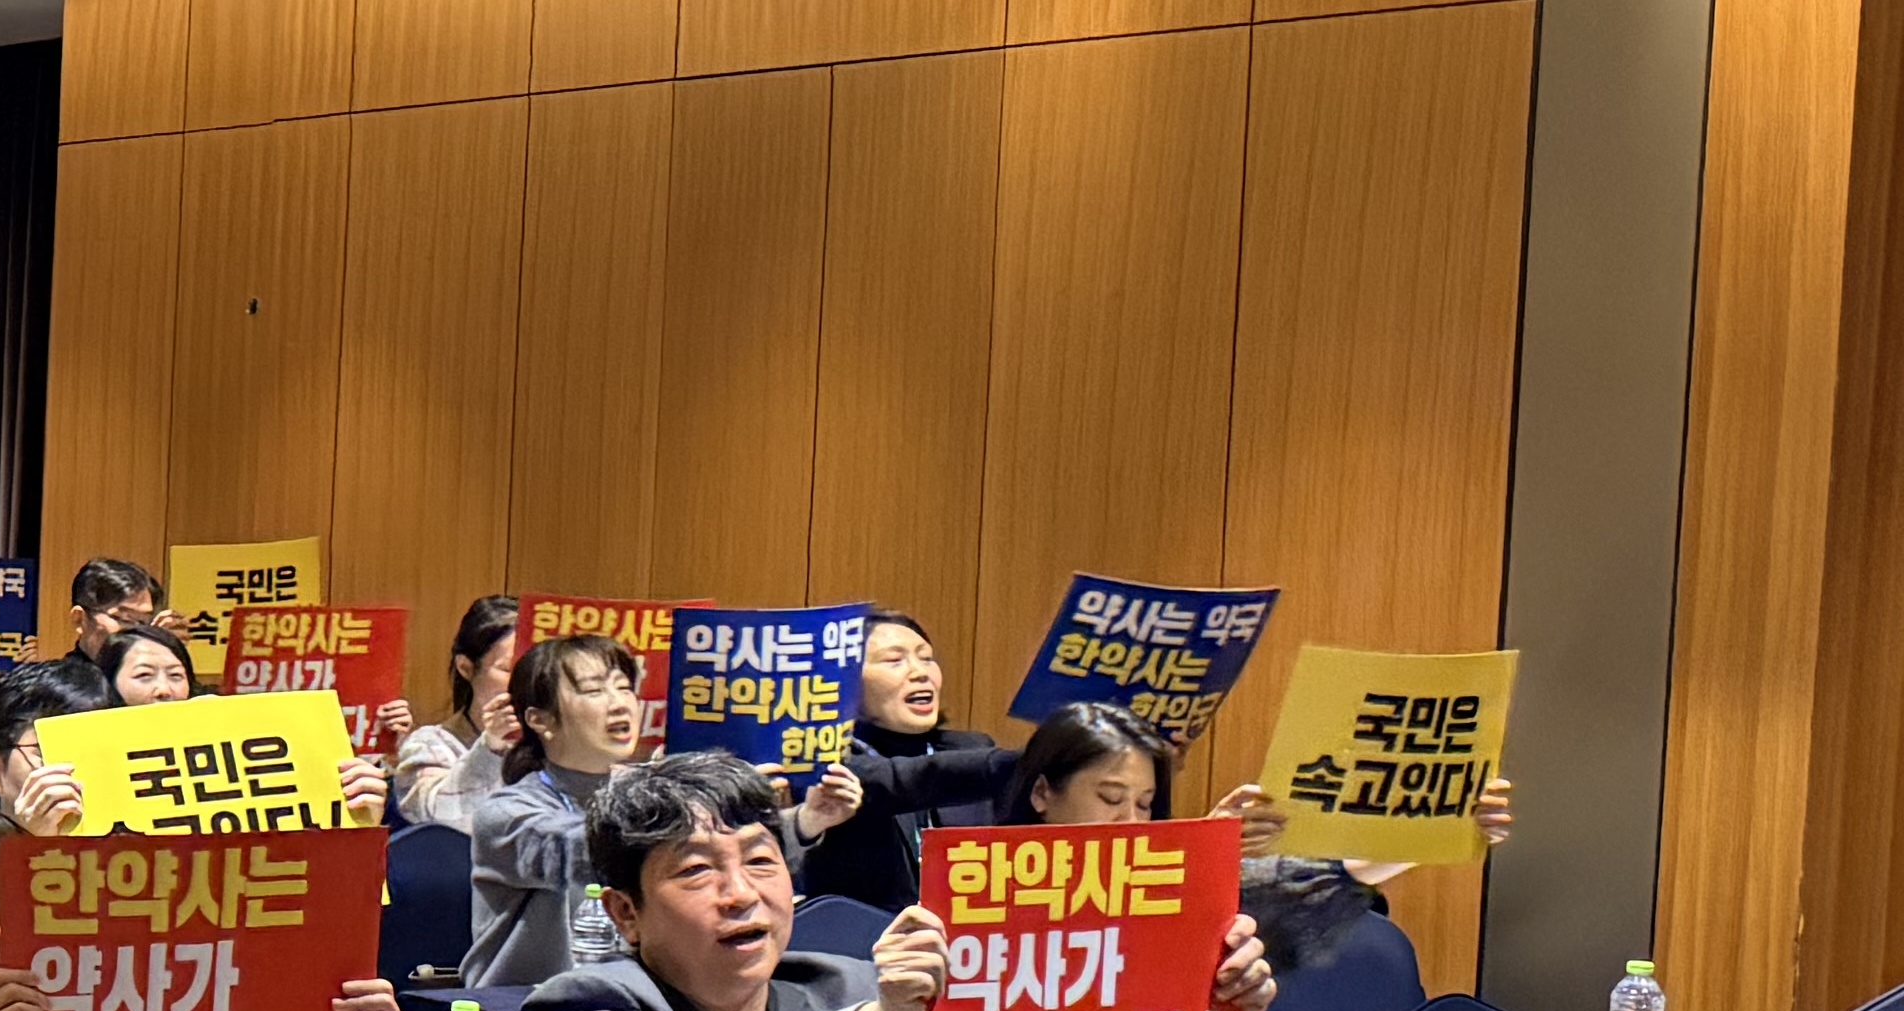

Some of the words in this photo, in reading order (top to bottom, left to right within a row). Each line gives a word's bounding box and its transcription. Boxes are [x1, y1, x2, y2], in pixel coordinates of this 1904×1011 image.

[216, 565, 298, 604] 국민은
[242, 612, 372, 657] 한약사는
[1071, 589, 1197, 645] 약사는
[1200, 602, 1267, 647] 약국
[685, 624, 814, 673] 약사는
[1049, 632, 1212, 693] 한약사는
[682, 674, 840, 724] 한약사는
[1353, 693, 1481, 753] 국민은
[127, 736, 298, 806] 국민은
[1289, 753, 1490, 818] 속고있다!
[29, 846, 309, 935] 한약사는
[947, 836, 1185, 924] 한약사는
